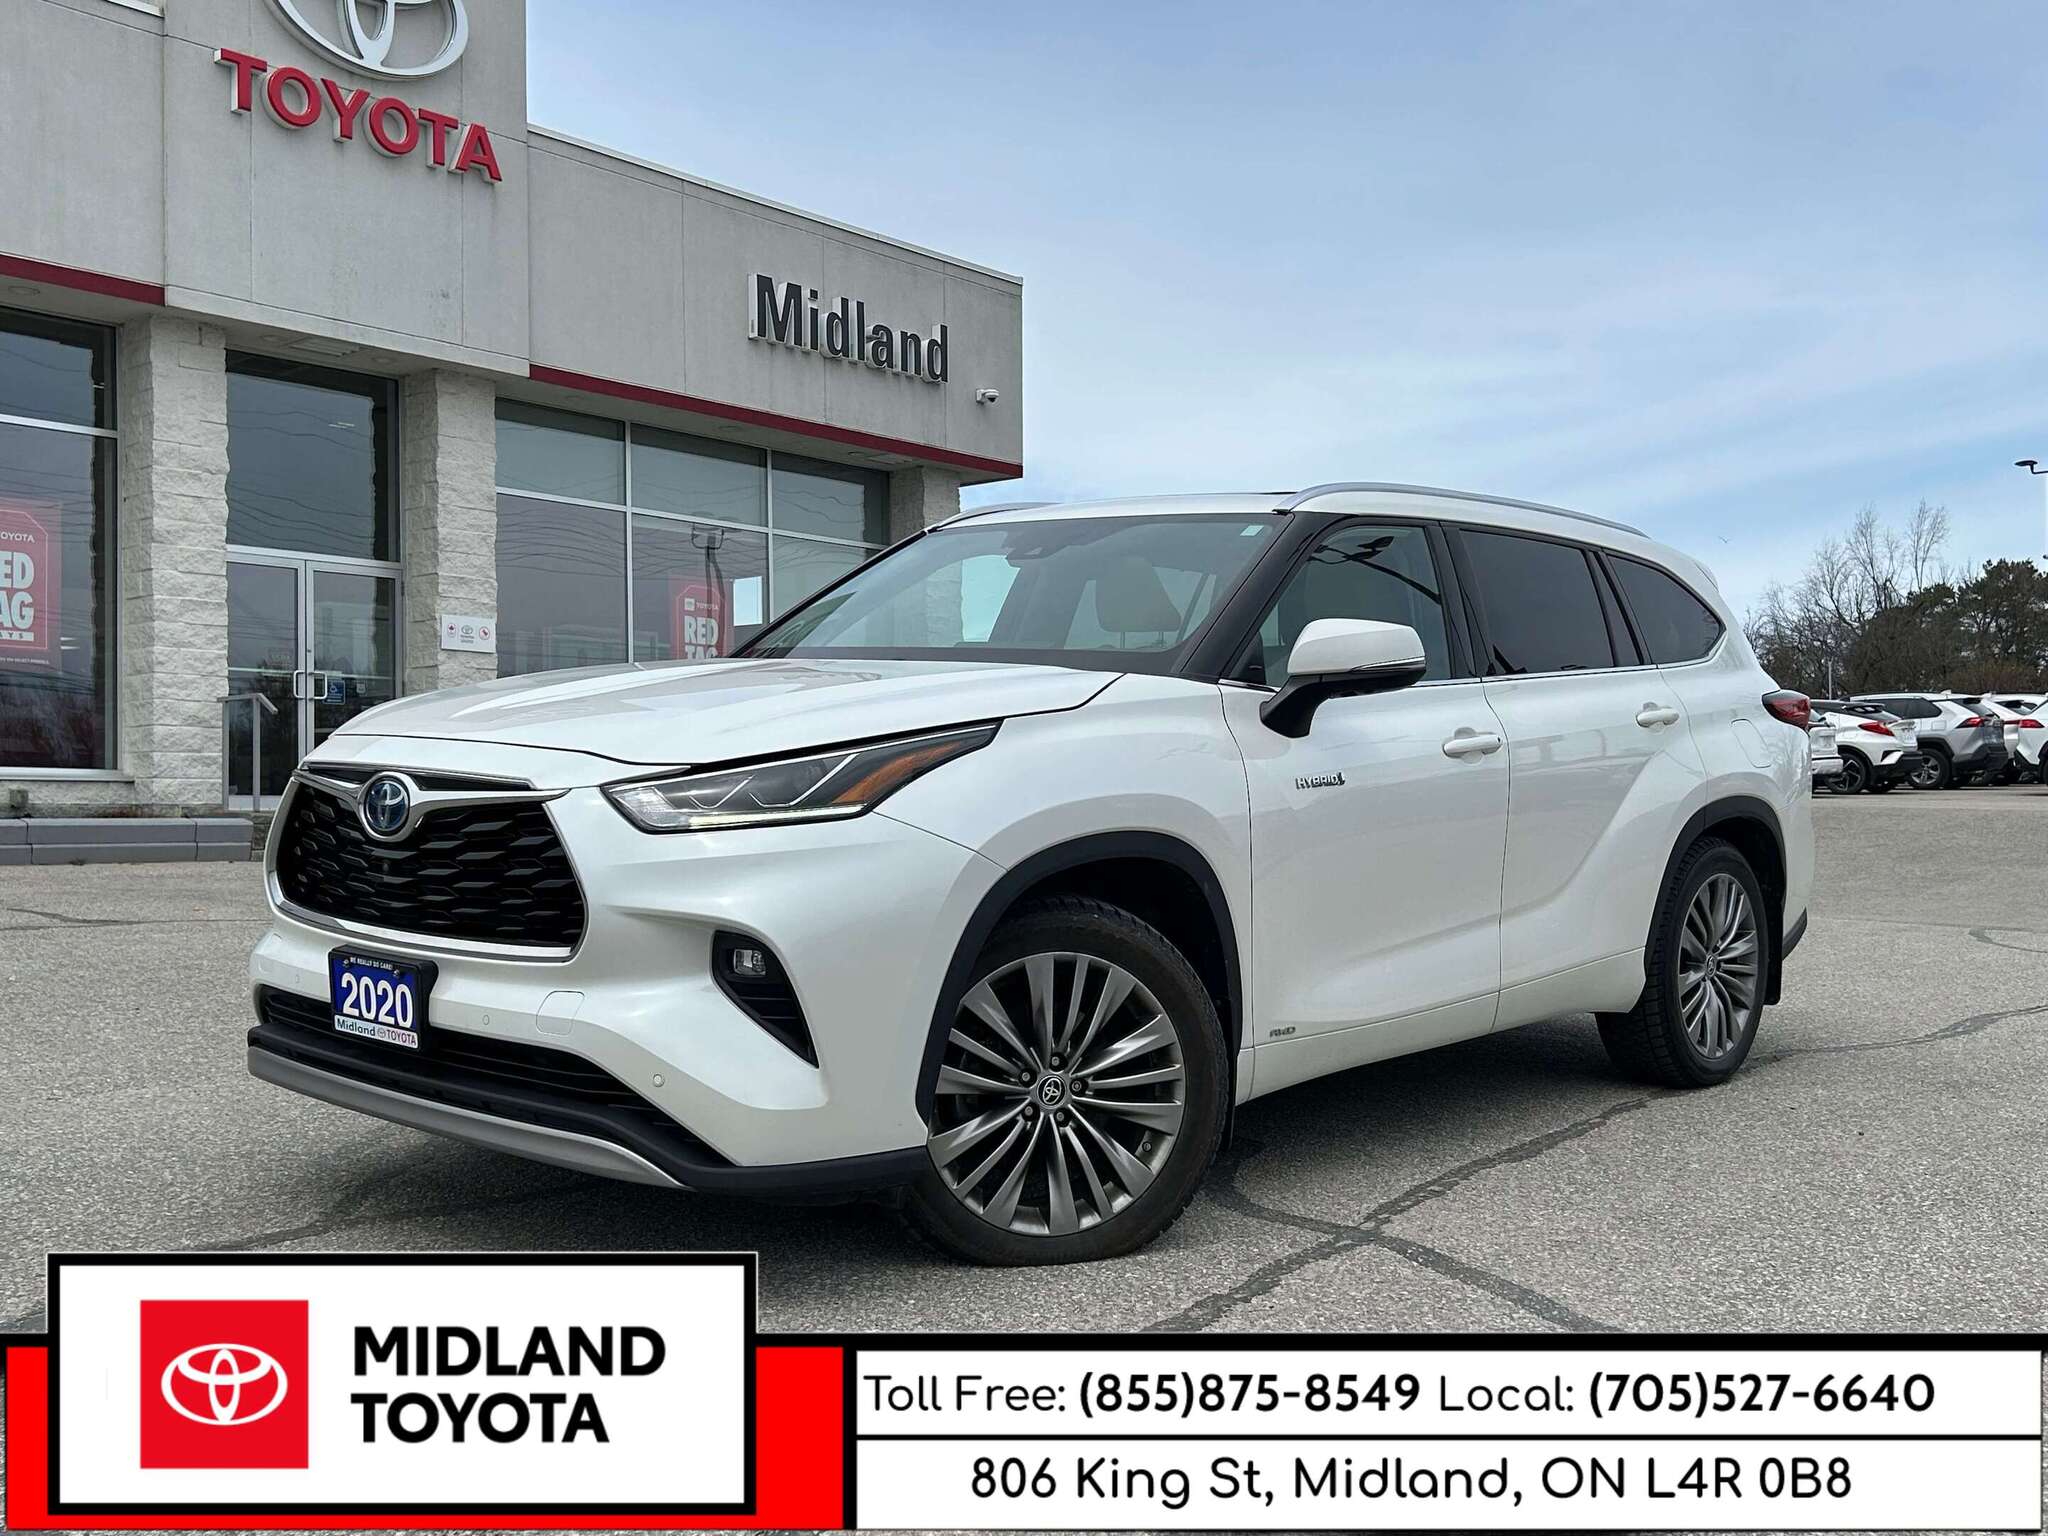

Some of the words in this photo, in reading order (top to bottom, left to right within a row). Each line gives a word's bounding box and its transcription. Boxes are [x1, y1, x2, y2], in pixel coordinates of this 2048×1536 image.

[216, 47, 502, 184] TOYOTA
[750, 273, 948, 384] Midland
[0, 531, 35, 543] OYOTA
[0, 550, 34, 590] ED
[0, 590, 34, 630] AG
[684, 615, 719, 646] RED
[1295, 774, 1339, 789] HYBRID
[341, 972, 413, 1028] 2020
[336, 1018, 376, 1037] Midland
[387, 1029, 417, 1046] TOYOTA
